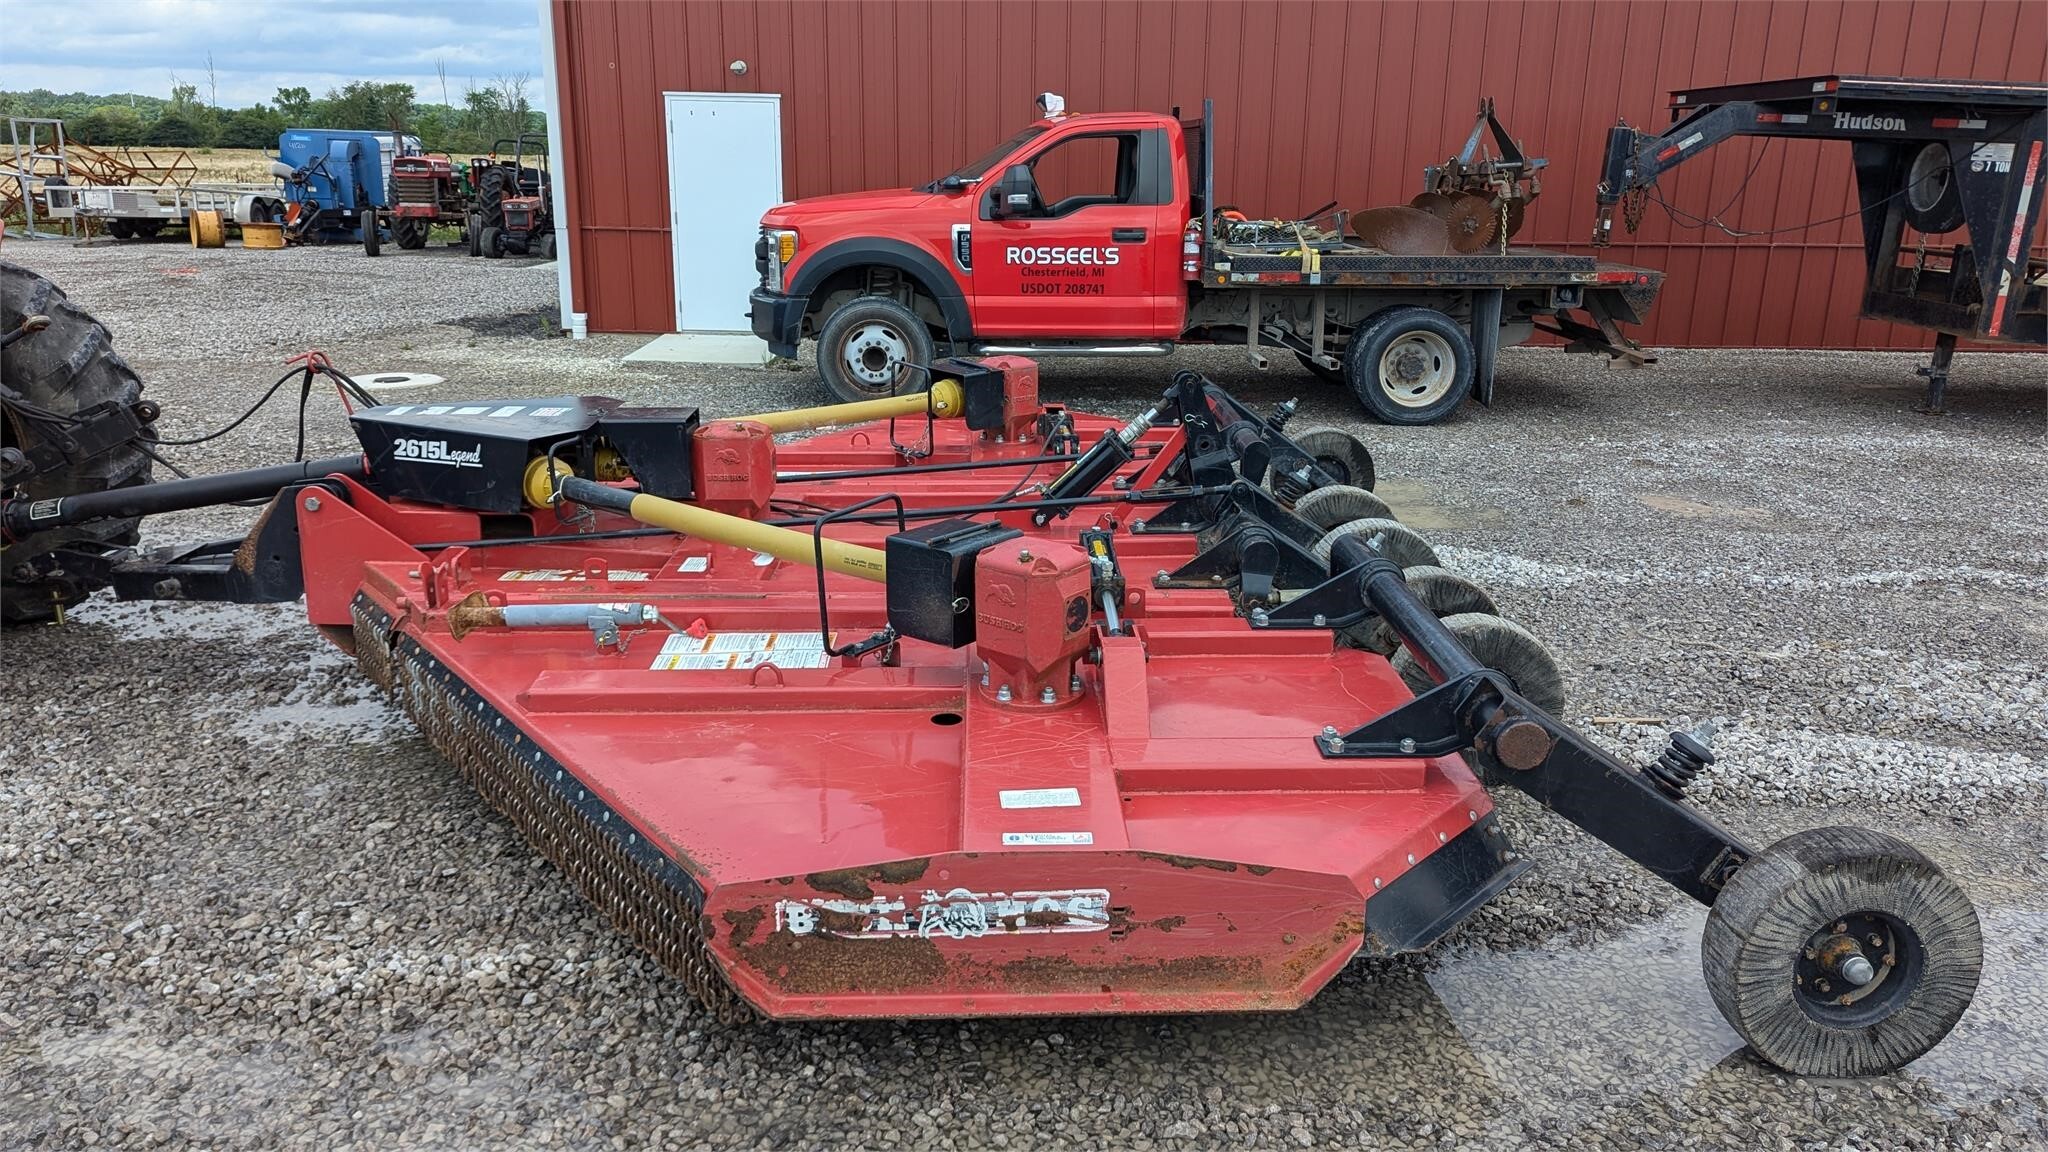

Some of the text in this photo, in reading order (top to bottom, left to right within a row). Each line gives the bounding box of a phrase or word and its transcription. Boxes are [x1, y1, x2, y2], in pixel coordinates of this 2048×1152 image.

[1832, 112, 1906, 131] Hudson
[1985, 161, 1992, 172] 7
[1994, 161, 2011, 172] TON
[1006, 246, 1120, 265] ROSSEEL'S
[1020, 267, 1105, 279] Chesterfield, MI
[1021, 283, 1104, 295] USDOT 208741
